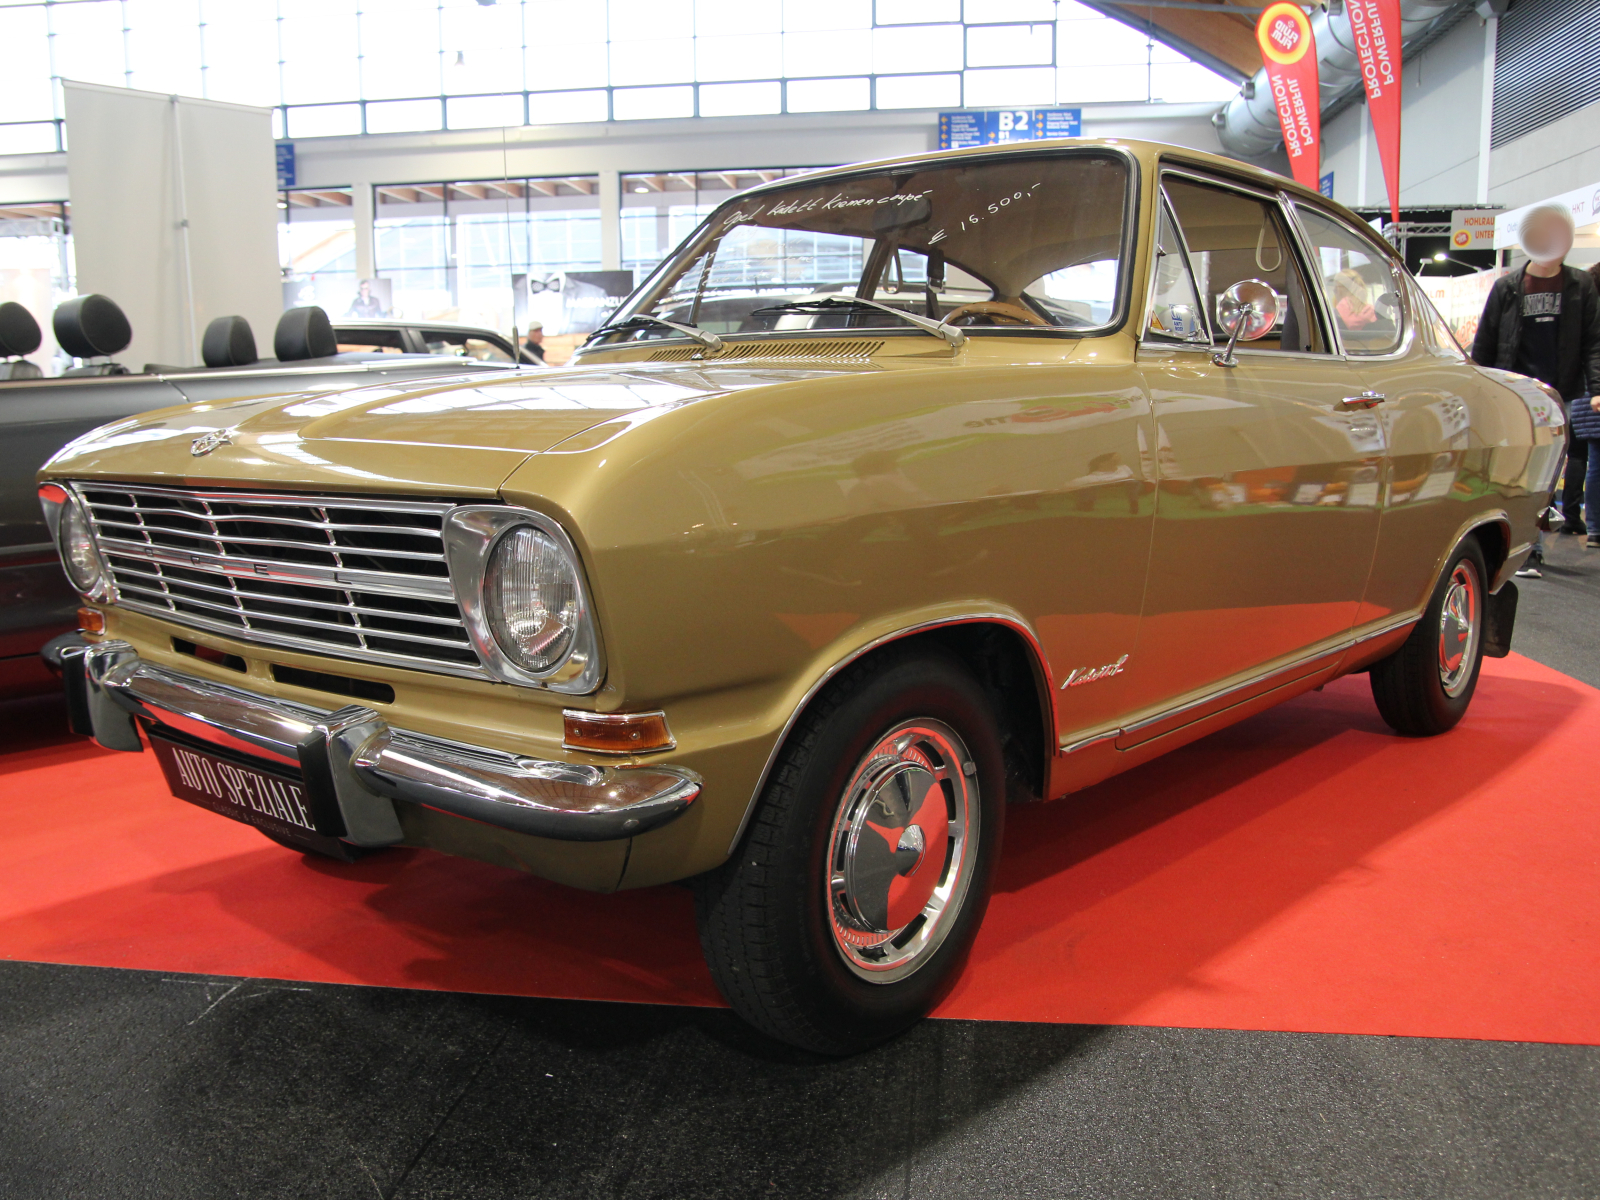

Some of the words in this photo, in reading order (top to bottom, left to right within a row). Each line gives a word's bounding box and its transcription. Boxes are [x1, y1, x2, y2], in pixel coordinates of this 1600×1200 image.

[998, 111, 1029, 131] B2
[172, 747, 223, 799] AUTO
[216, 762, 316, 832] SPEZIALE
